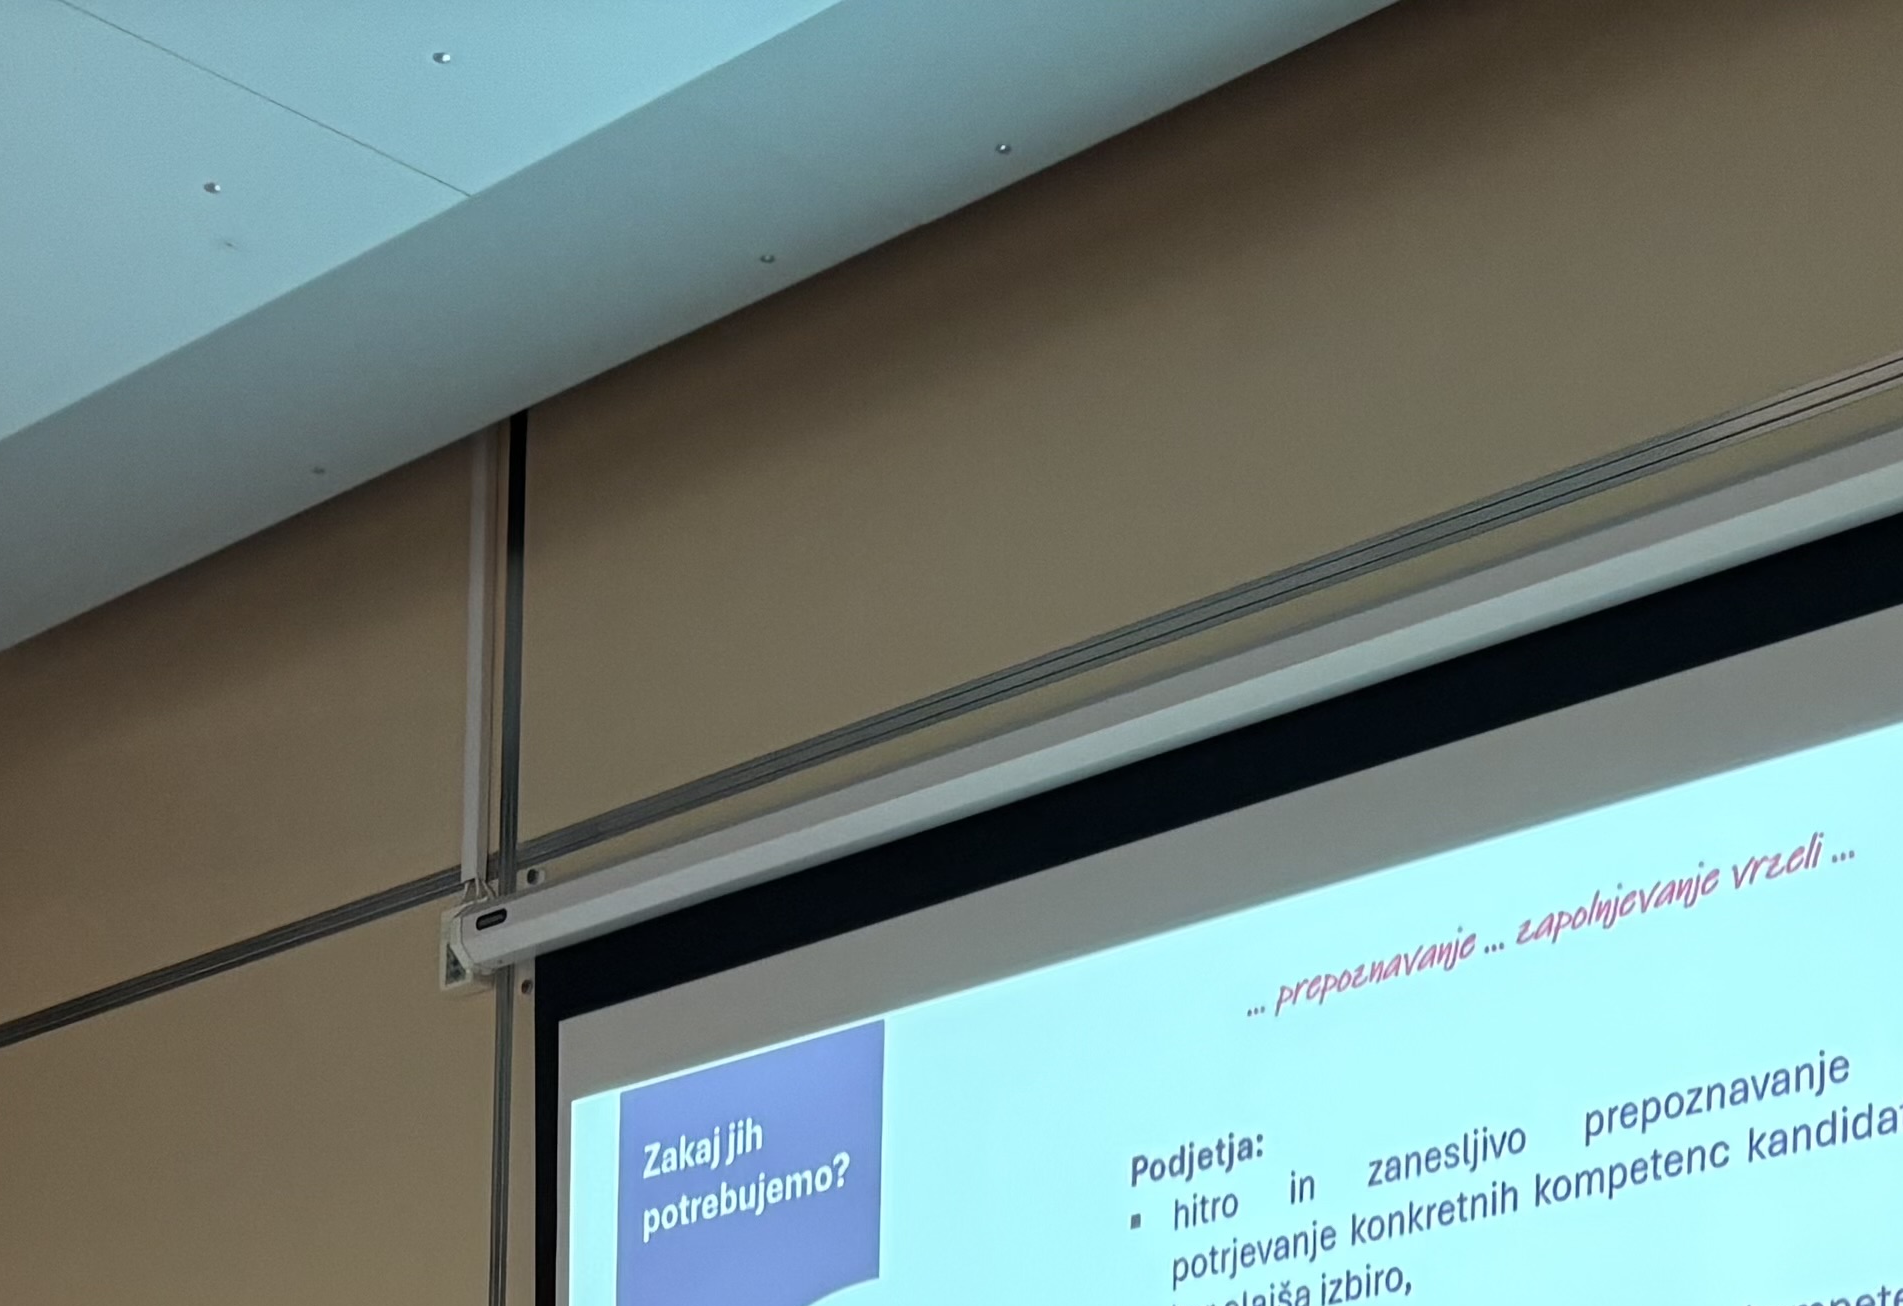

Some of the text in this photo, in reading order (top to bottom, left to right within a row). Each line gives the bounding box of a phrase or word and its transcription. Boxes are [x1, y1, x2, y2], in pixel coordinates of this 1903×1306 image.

[1275, 832, 1824, 1017] prepoznavanje zapolnjevanje vrzeli
[643, 1118, 762, 1179] Zakaj jih
[1132, 1133, 1263, 1187] Podjetja:
[1174, 1193, 1238, 1230] hitro
[1291, 1171, 1314, 1204] in
[1368, 1127, 1526, 1187] zanesljivo
[1585, 1050, 1849, 1147] prepoznavanje
[644, 1152, 849, 1243] potrebujemo?
[1173, 1220, 1336, 1291] potrjevanje
[1351, 1181, 1518, 1246] konkretnih
[1535, 1141, 1729, 1207] kompetenc
[1321, 1264, 1411, 1306] izbiro,
